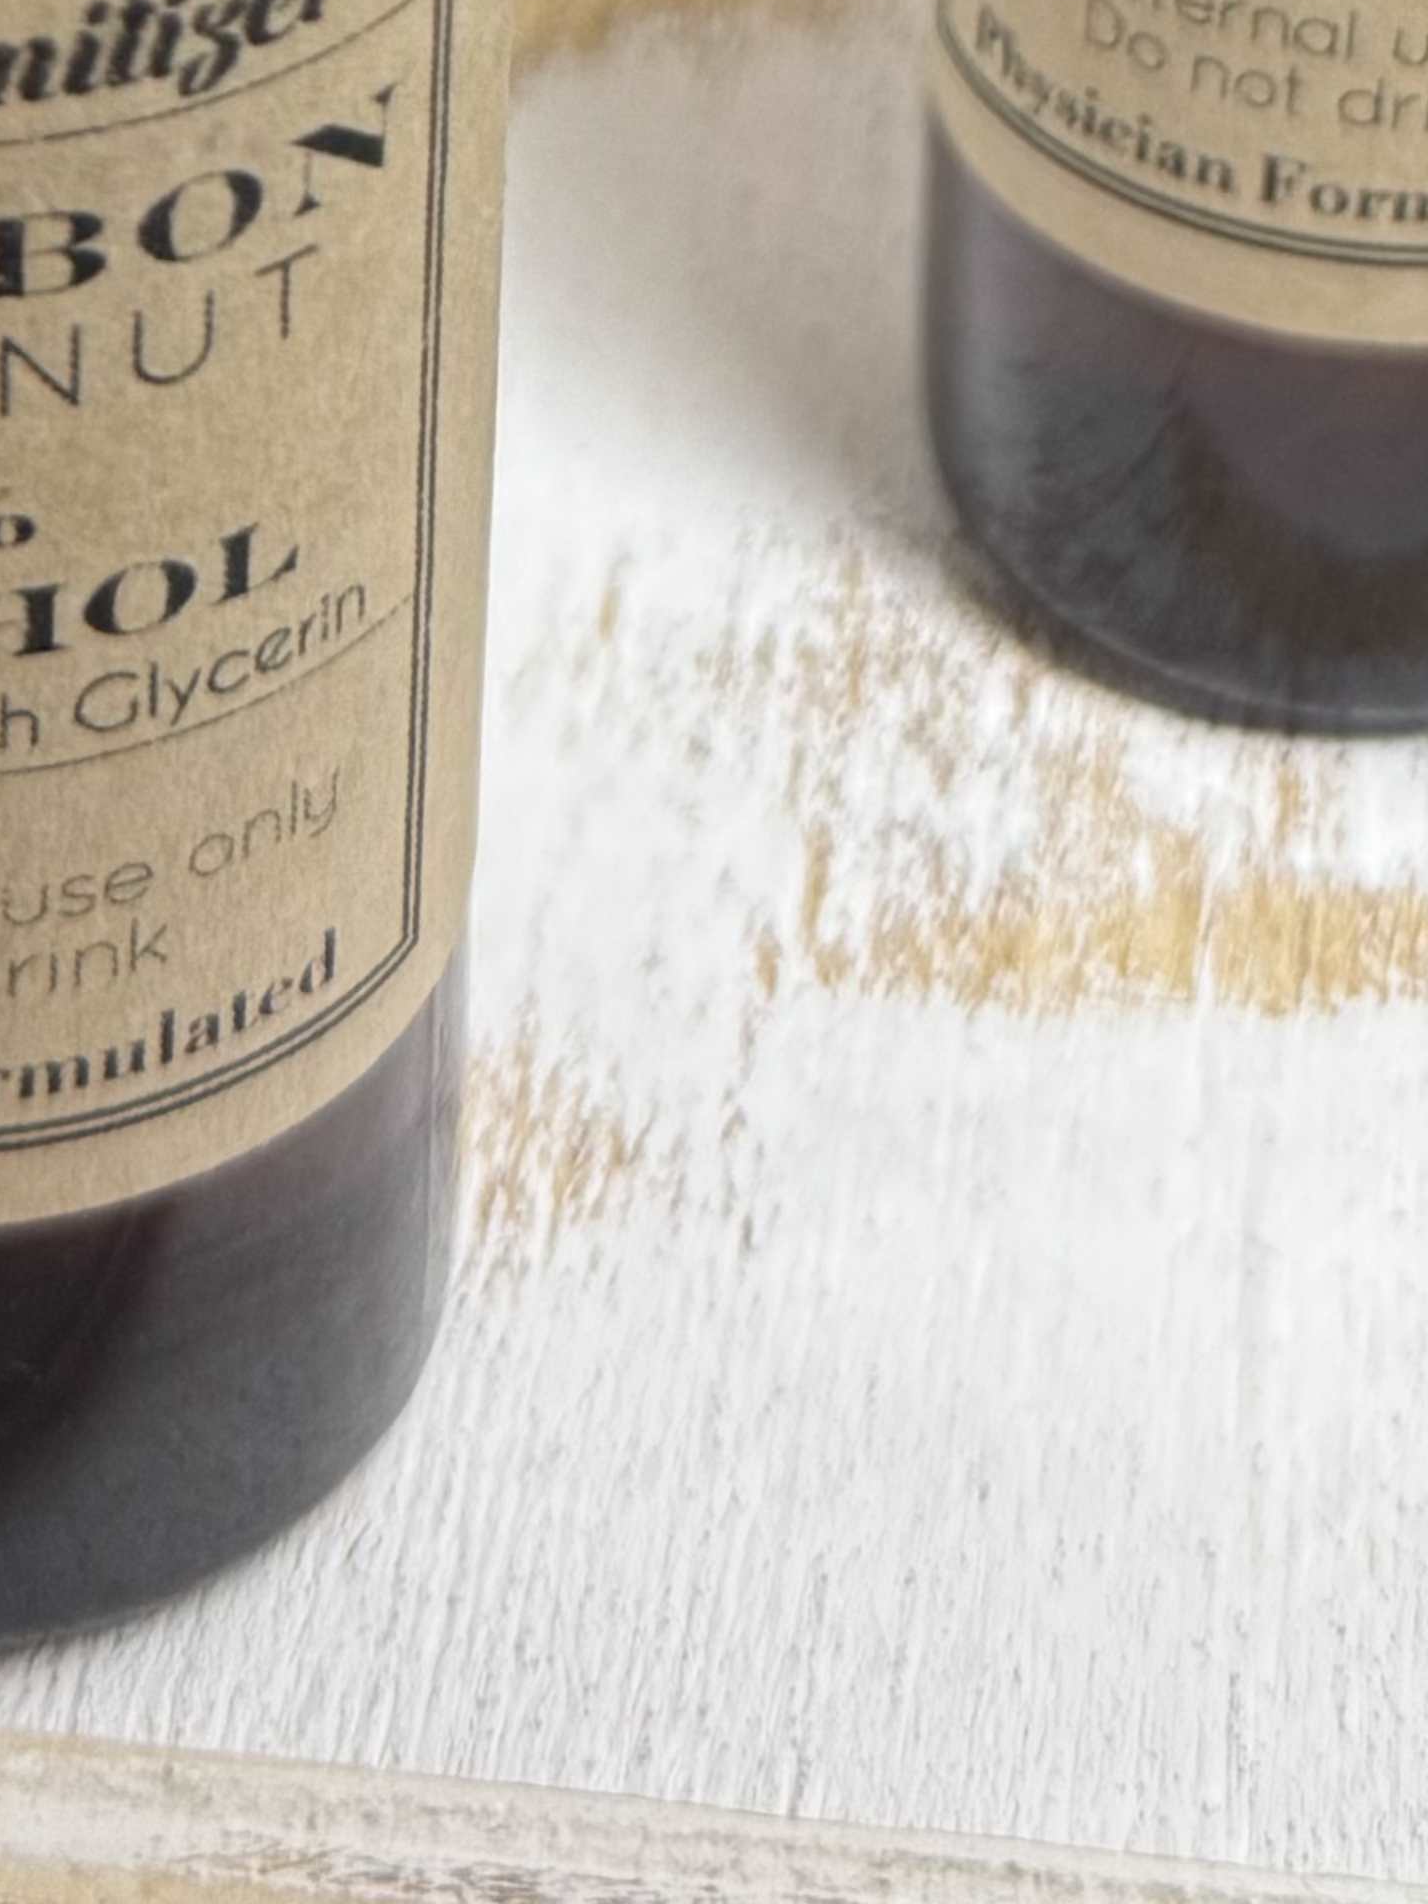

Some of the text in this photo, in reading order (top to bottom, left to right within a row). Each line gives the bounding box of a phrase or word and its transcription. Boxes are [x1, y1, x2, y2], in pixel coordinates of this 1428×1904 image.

[975, 0, 1236, 194] Physician
[1190, 54, 1305, 117] not
[74, 581, 367, 738] Glycerin
[2, 862, 154, 928] use
[188, 755, 347, 879] only
